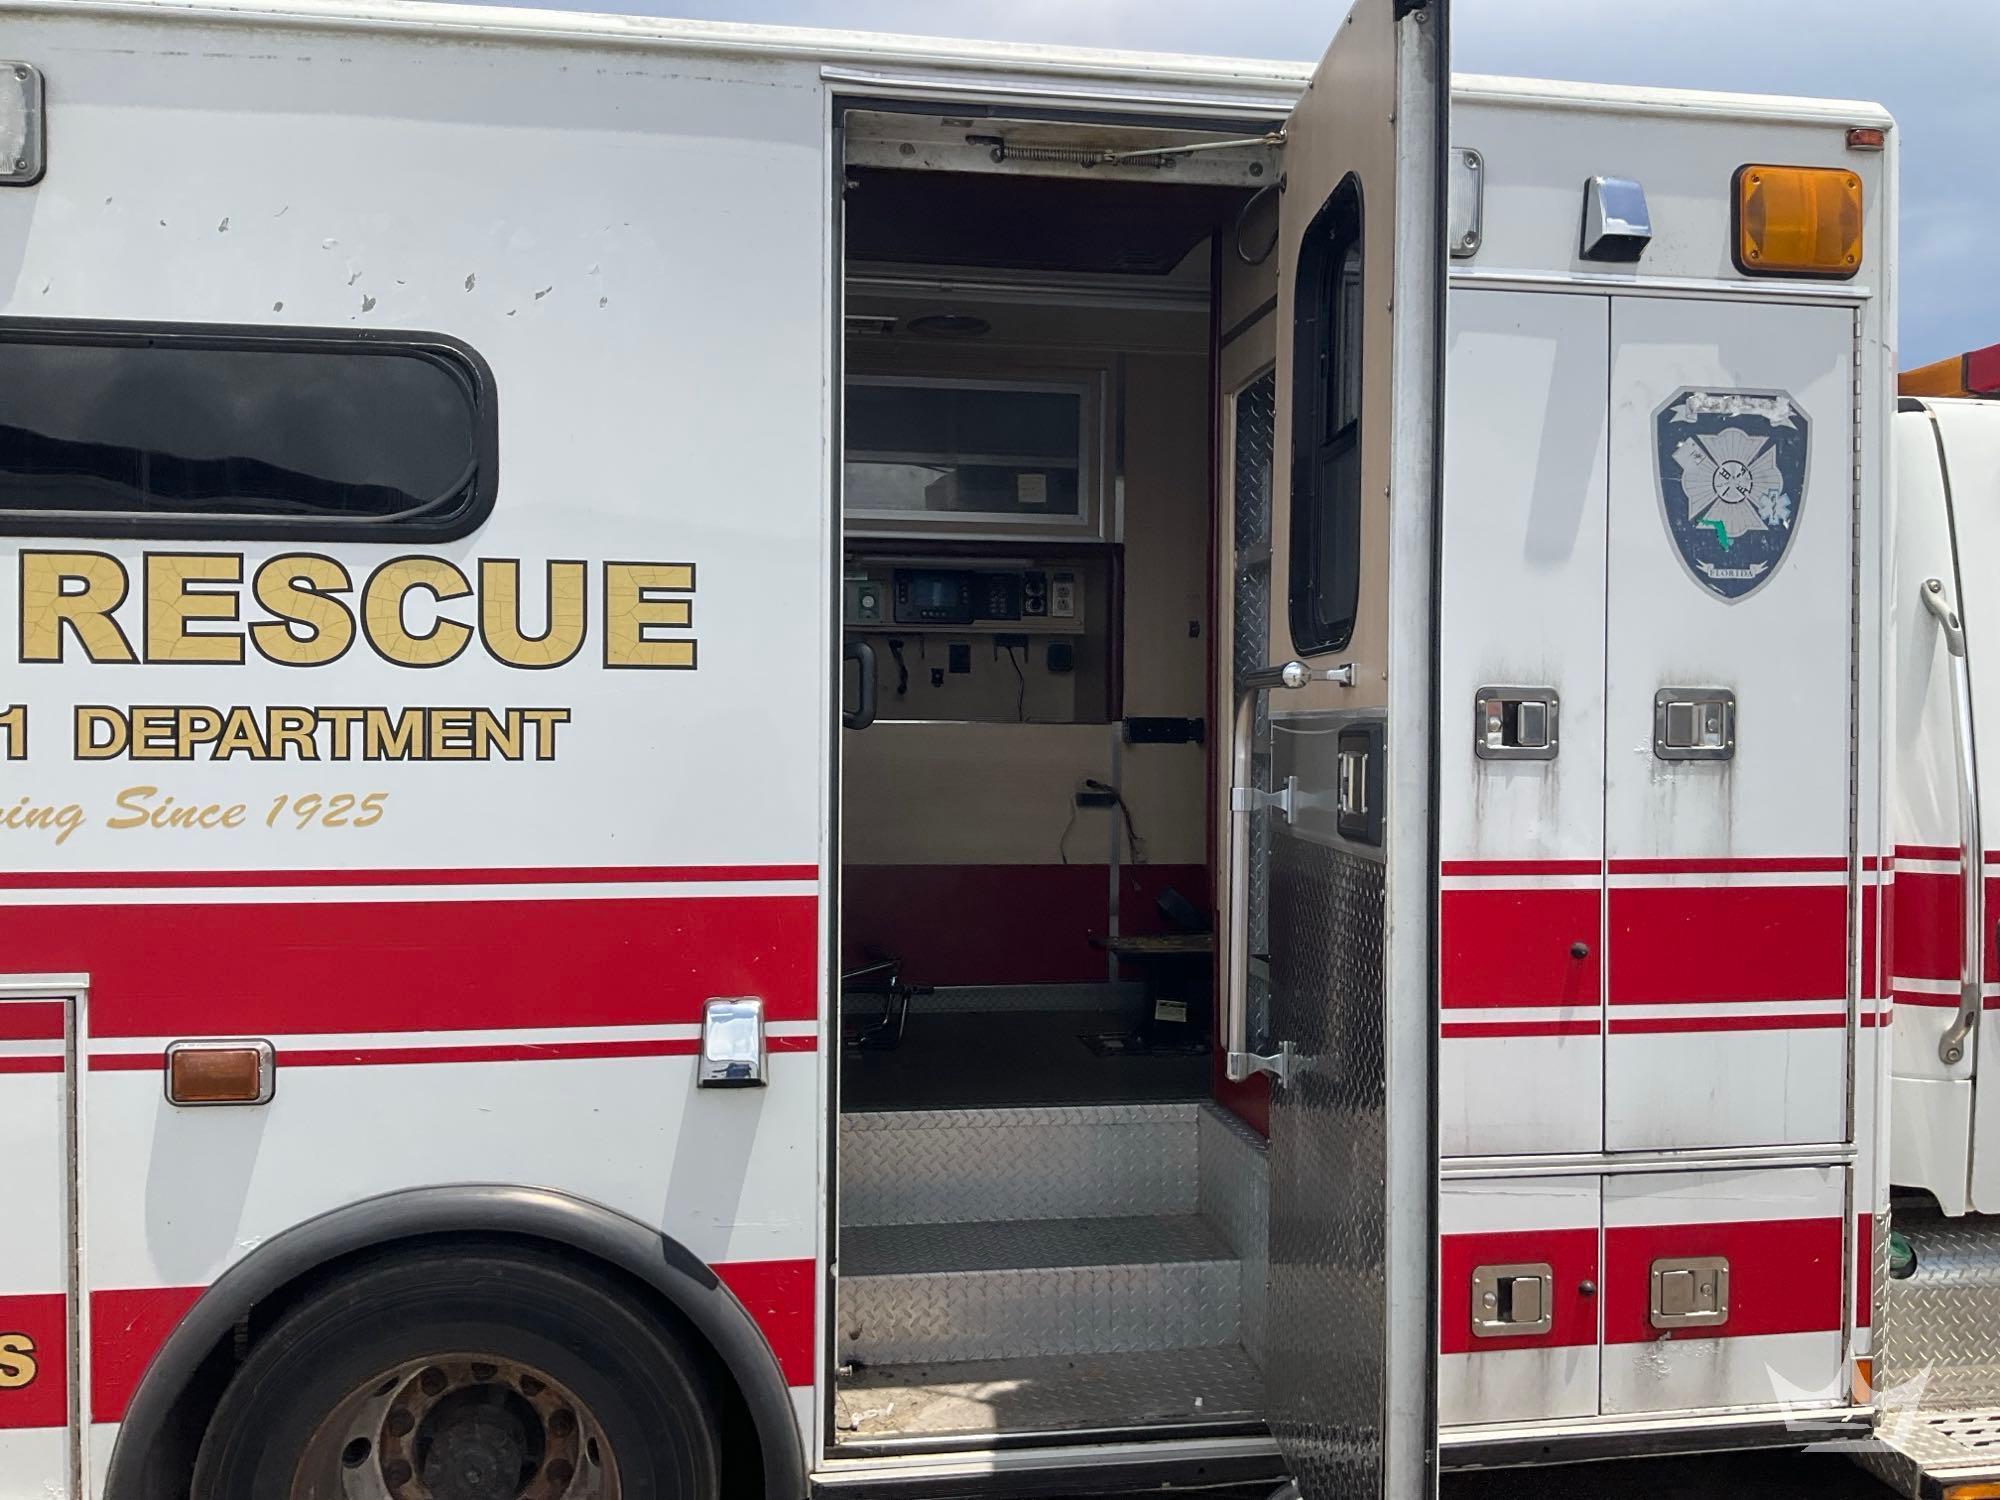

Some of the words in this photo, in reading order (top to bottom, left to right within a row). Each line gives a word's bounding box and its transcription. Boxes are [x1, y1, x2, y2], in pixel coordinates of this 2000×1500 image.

[1710, 569, 1754, 577] FLORIDA
[18, 548, 698, 670] RESCUE
[73, 705, 571, 761] DEPARTMENT
[0, 796, 86, 845] ing
[106, 785, 248, 830] Since
[265, 792, 390, 831] 1925
